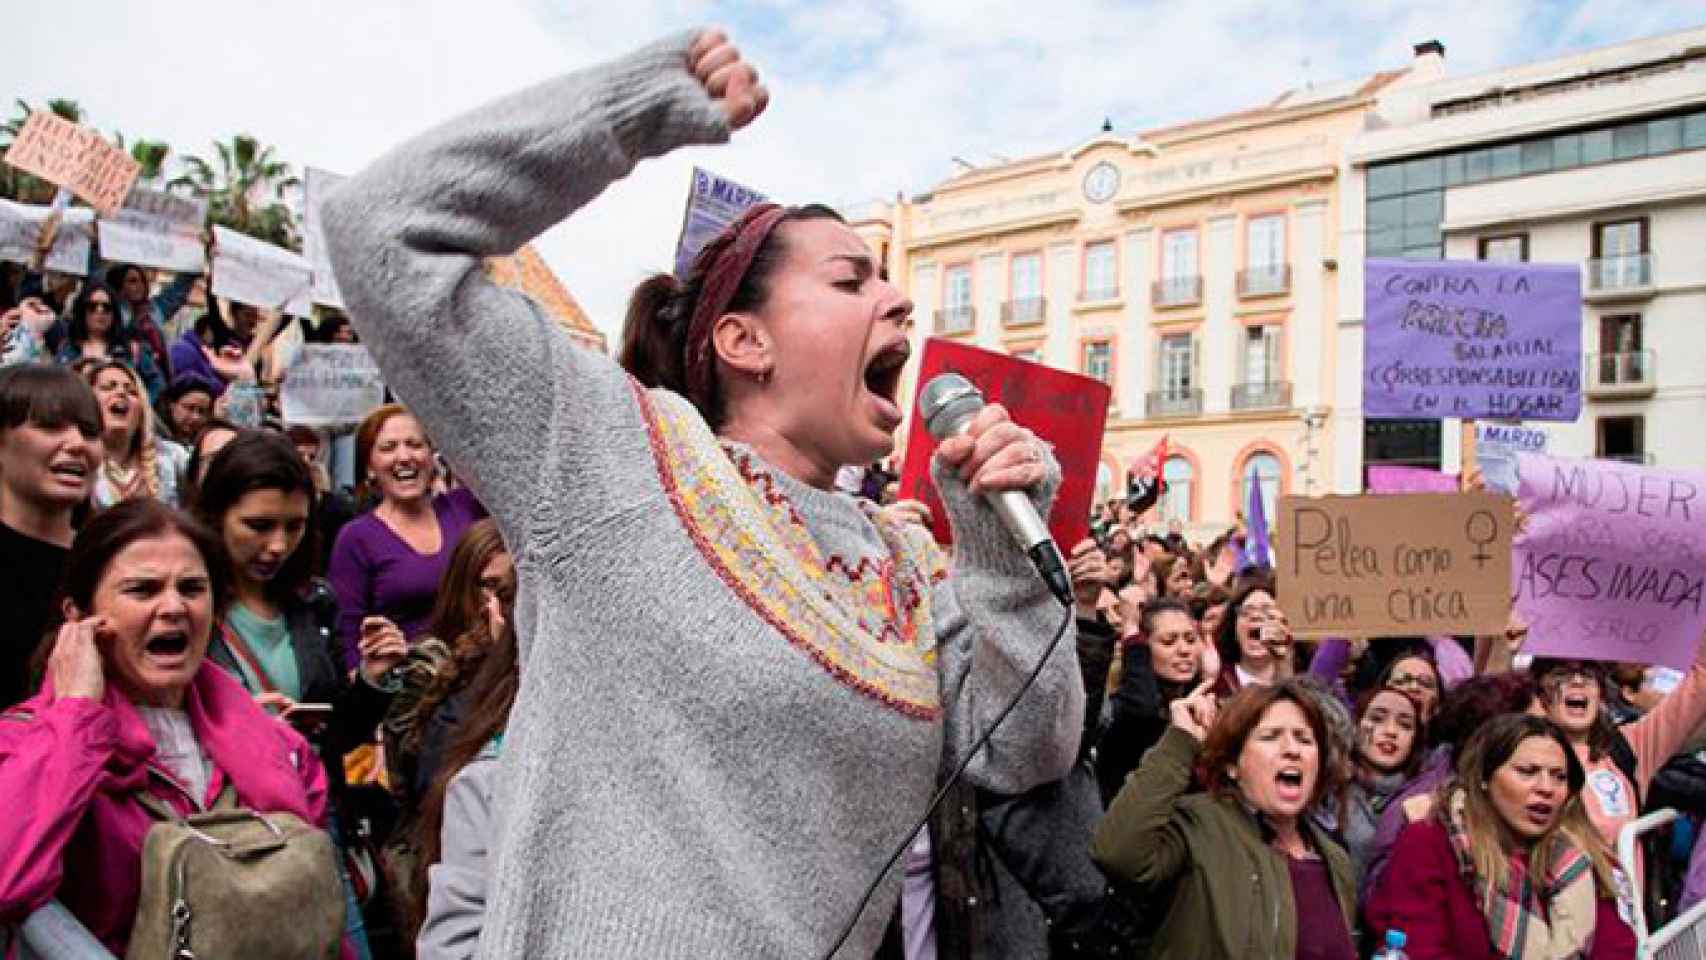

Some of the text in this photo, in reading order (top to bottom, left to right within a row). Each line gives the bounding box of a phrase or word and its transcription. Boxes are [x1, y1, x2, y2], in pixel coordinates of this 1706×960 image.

[1384, 274, 1531, 295] CONTRA LA
[1489, 394, 1563, 414] HOGAR
[1484, 425, 1546, 448] MARZO
[1552, 466, 1697, 520] MUJER
[1293, 508, 1382, 578] Pelea
[1303, 592, 1355, 624] una
